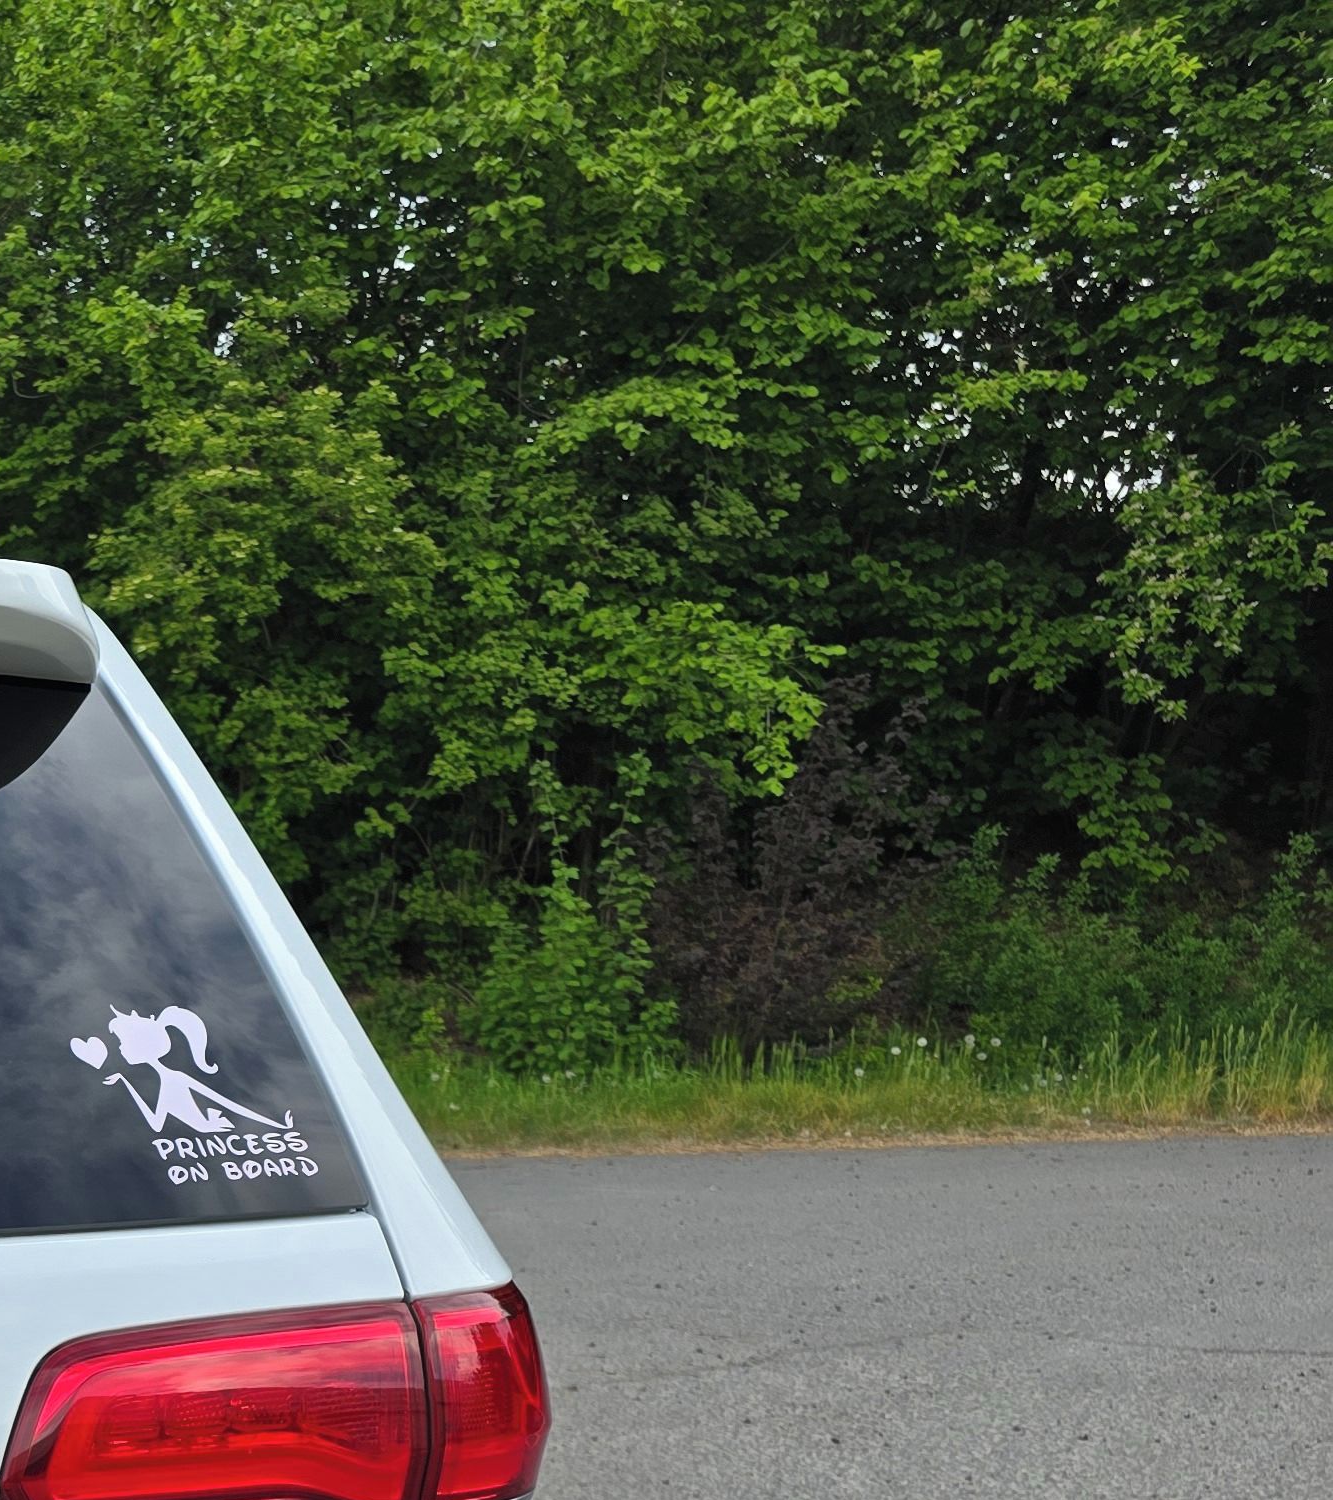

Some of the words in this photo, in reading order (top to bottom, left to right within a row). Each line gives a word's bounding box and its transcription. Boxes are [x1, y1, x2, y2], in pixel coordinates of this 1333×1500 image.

[152, 1131, 309, 1160] PRINCESS
[167, 1162, 209, 1185] ON
[221, 1156, 319, 1182] BOARD
